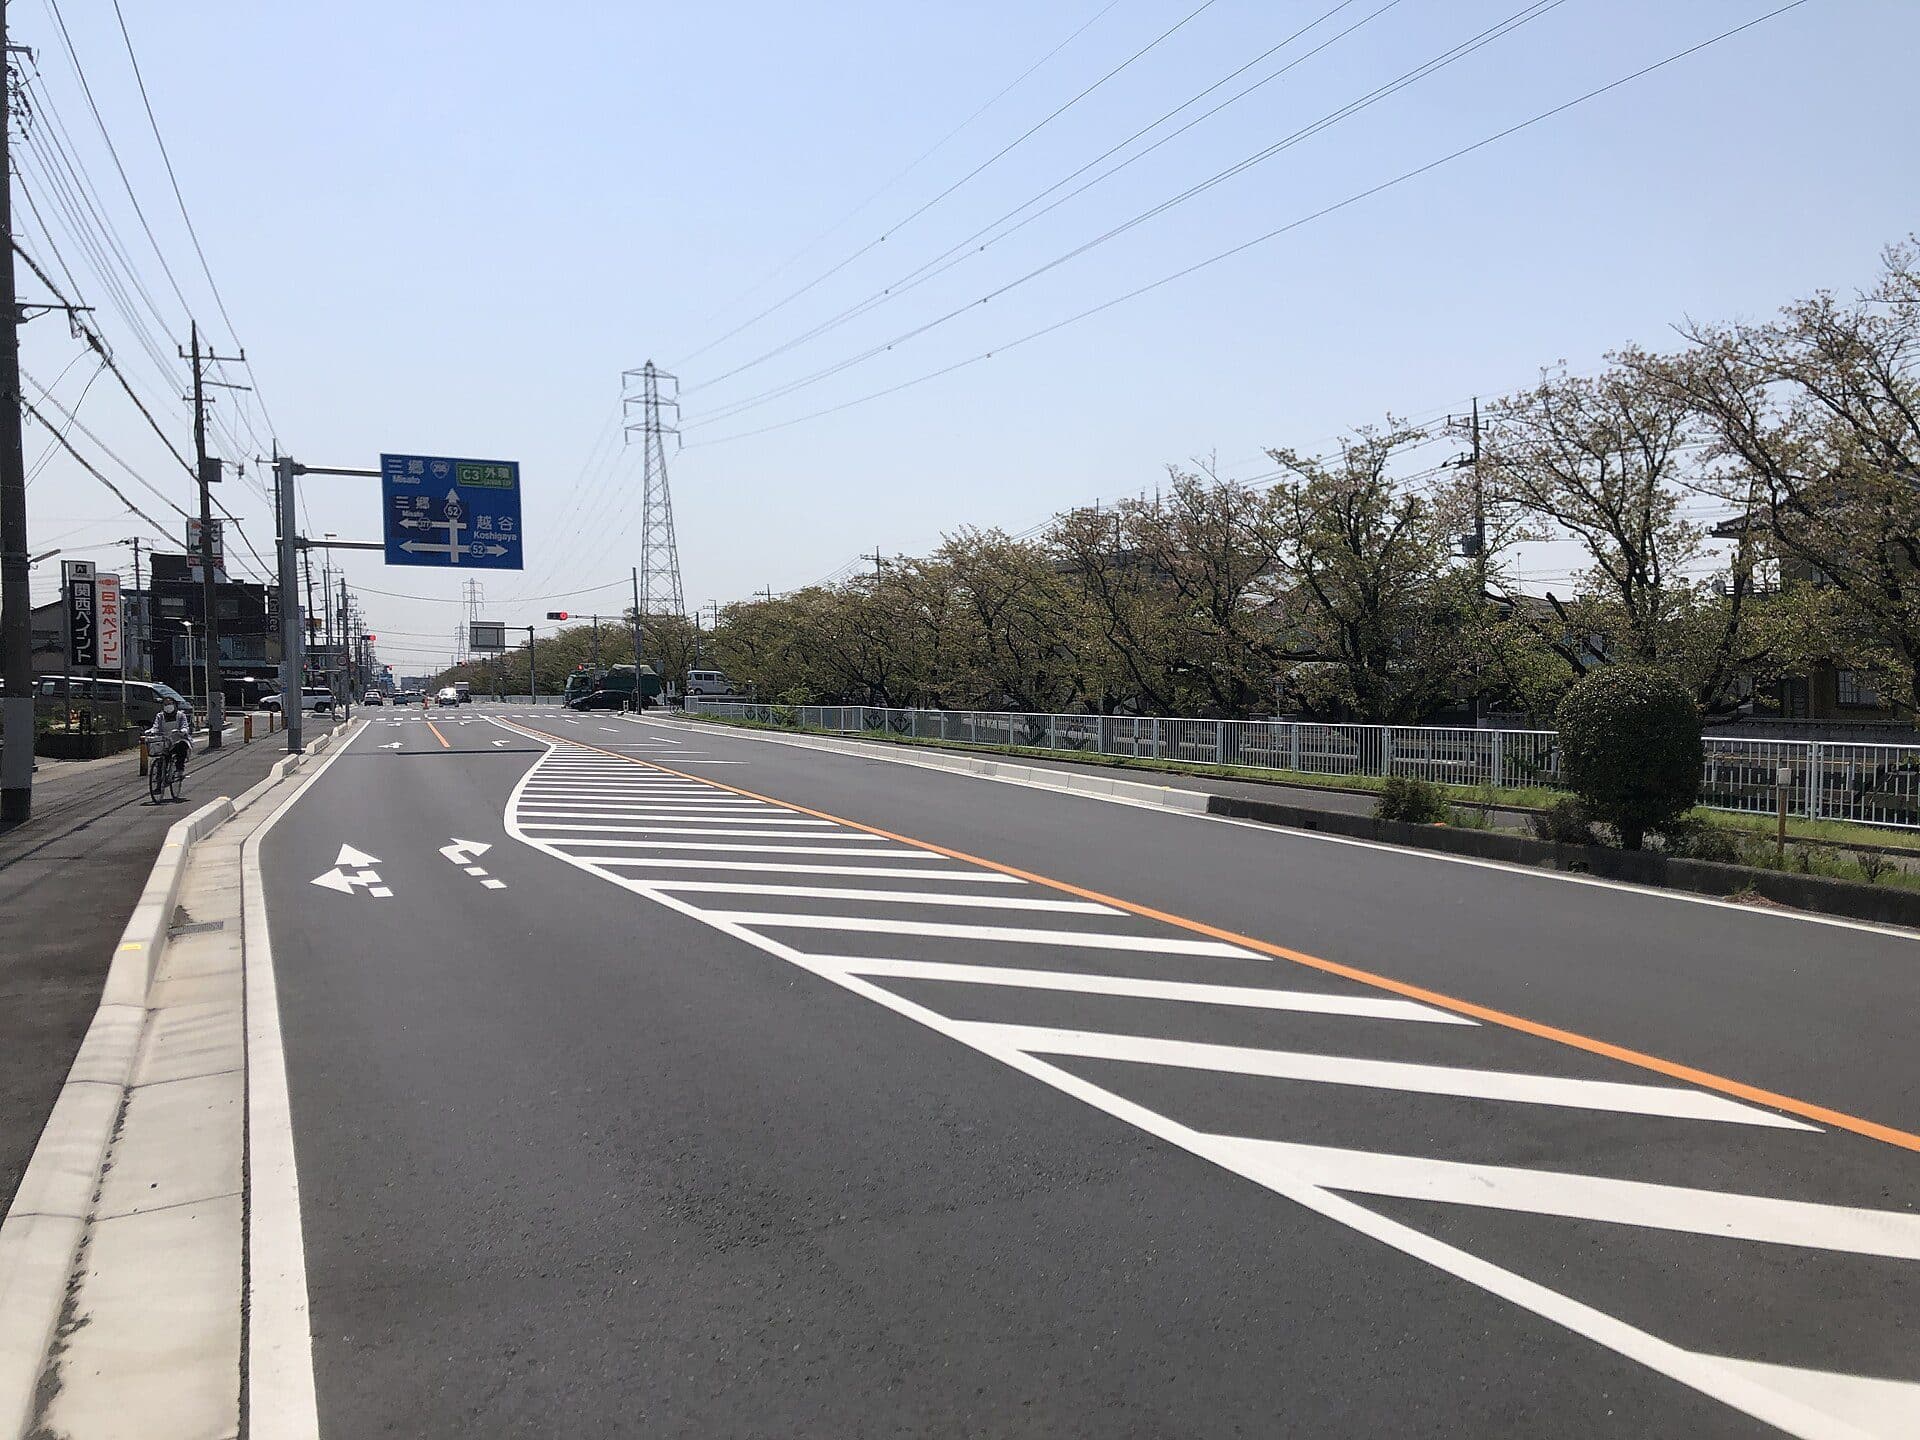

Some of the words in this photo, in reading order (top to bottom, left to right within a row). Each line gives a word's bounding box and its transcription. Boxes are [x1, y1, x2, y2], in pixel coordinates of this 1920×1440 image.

[388, 458, 424, 475] 三郷
[392, 475, 421, 485] Misato
[462, 469, 480, 481] C3
[395, 496, 430, 510] 三郷
[447, 506, 459, 516] 52
[476, 515, 514, 531] 越谷
[473, 531, 517, 542] Koshigaya
[471, 545, 484, 555] 52
[74, 582, 92, 663] 関西ペイント
[101, 591, 118, 665] 日本ペイント
